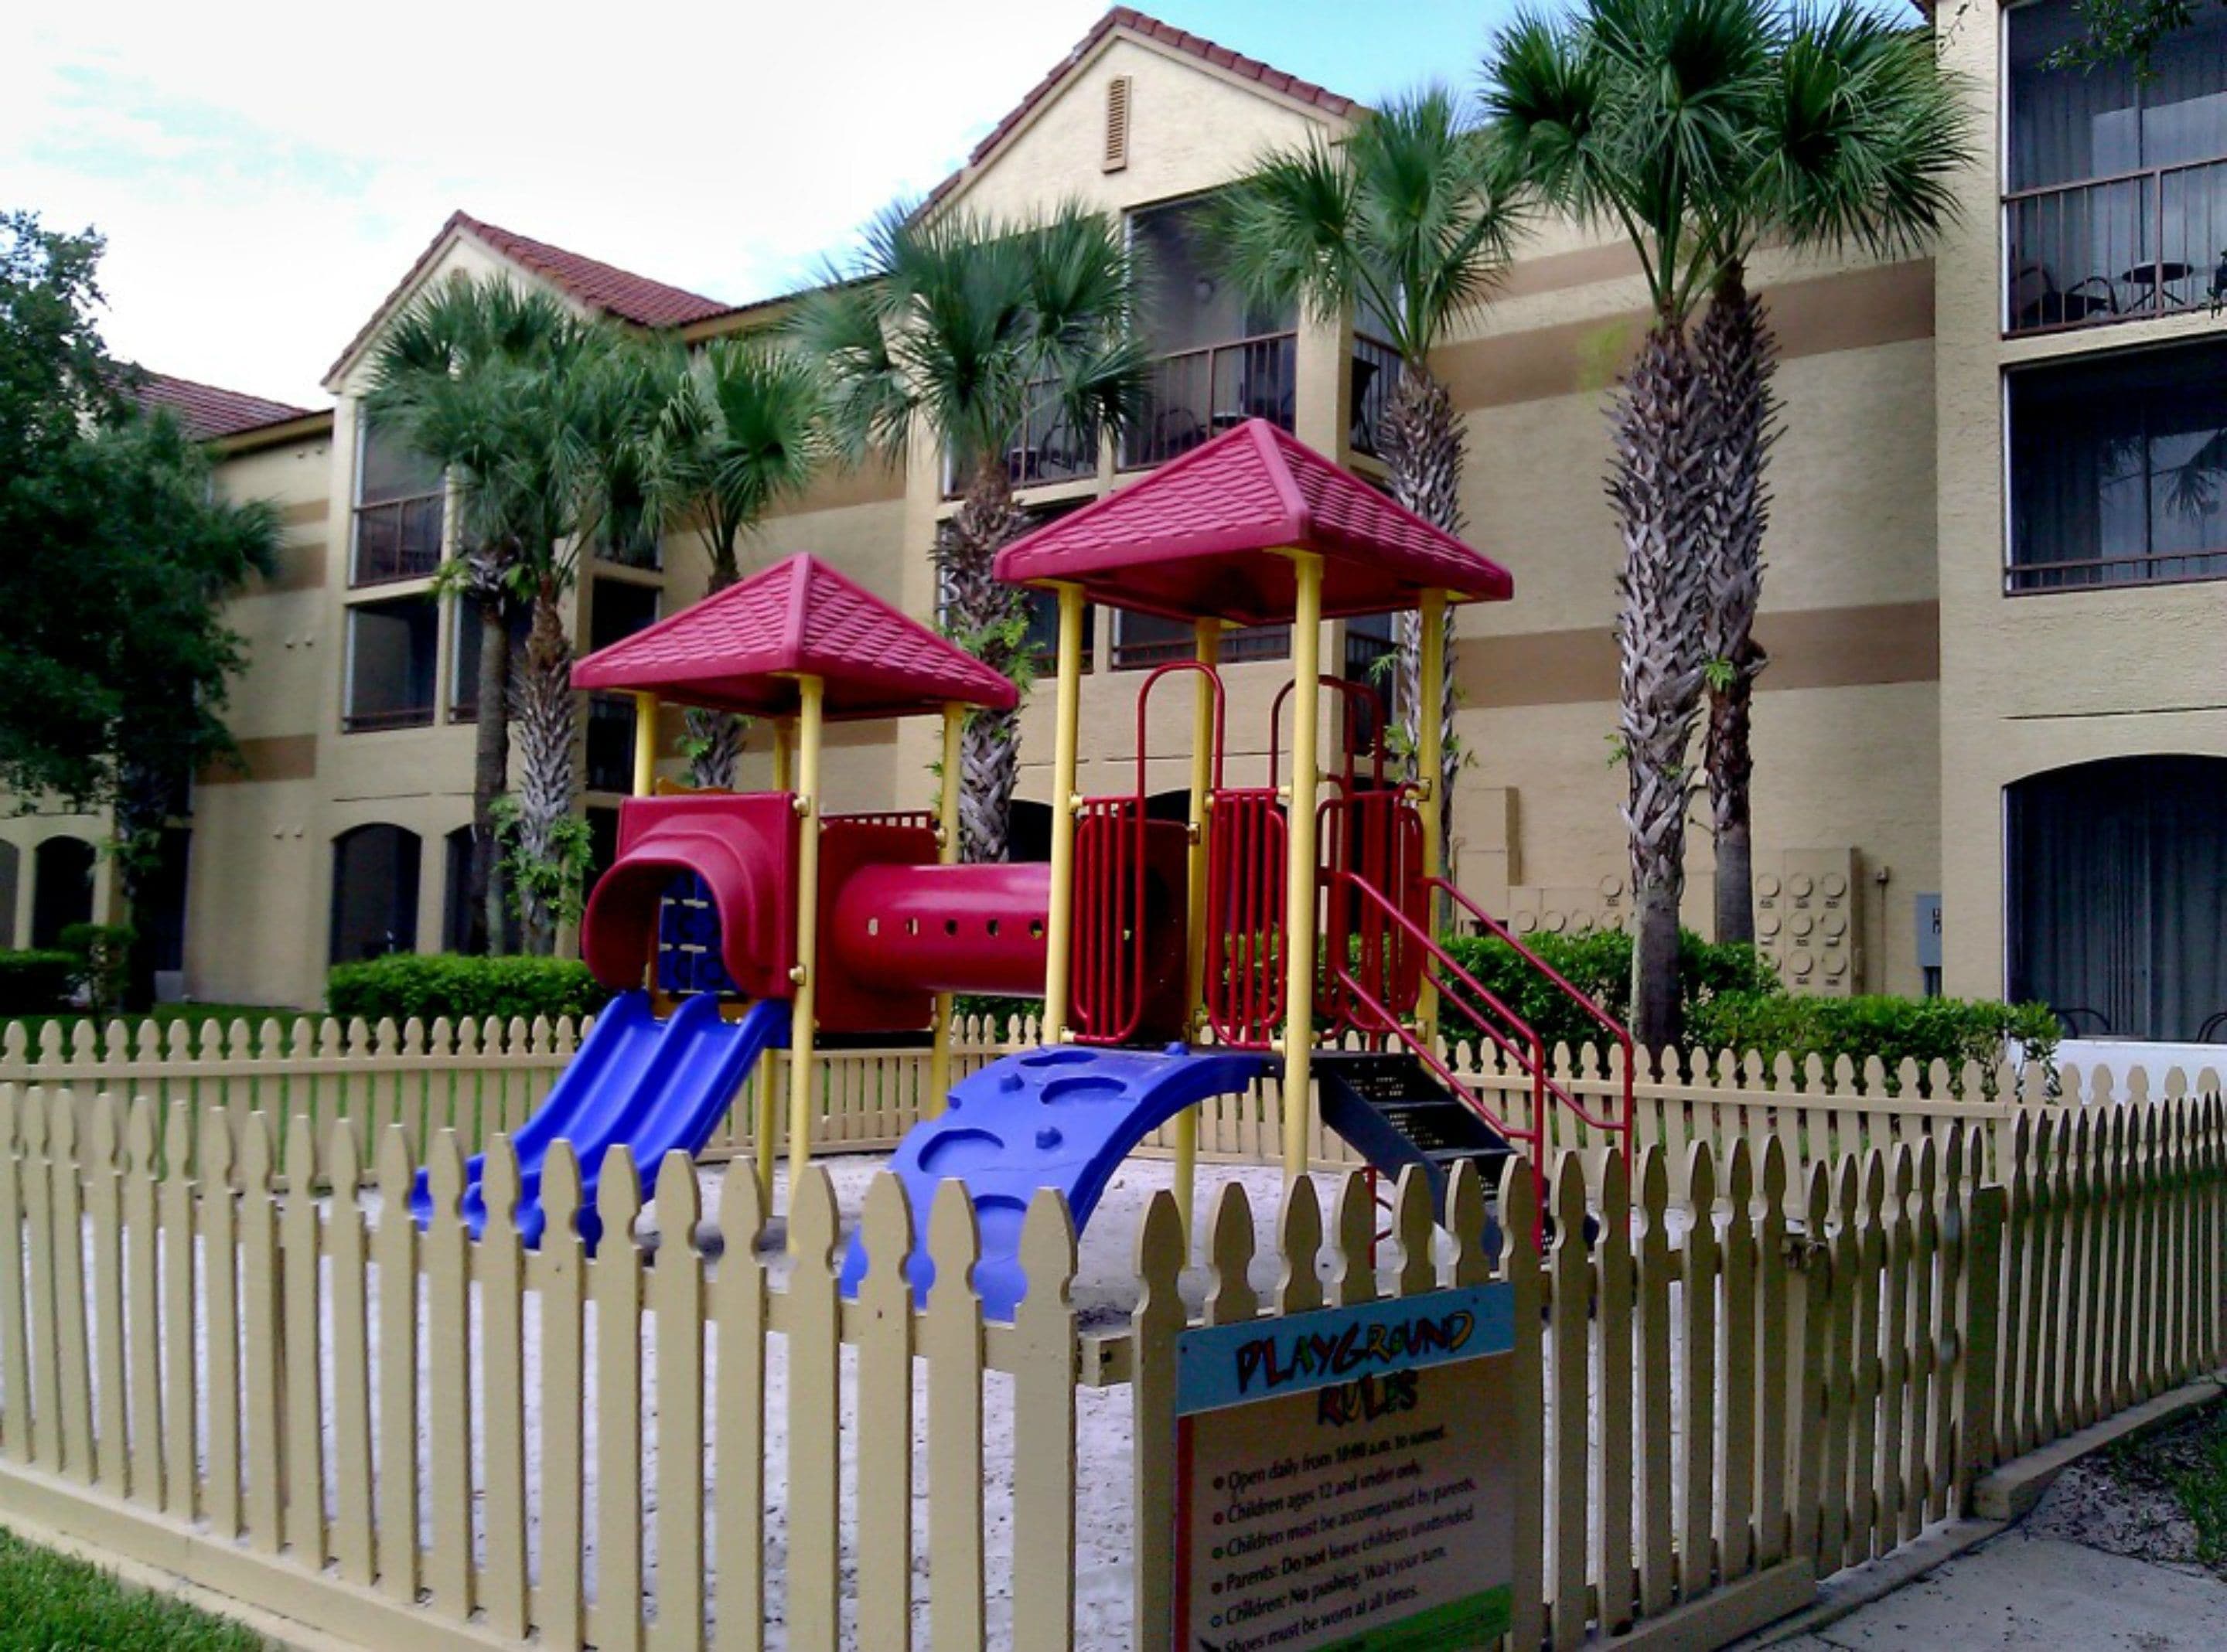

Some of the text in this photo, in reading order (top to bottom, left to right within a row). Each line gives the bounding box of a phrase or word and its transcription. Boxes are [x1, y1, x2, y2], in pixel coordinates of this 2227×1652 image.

[1236, 1310, 1475, 1395] PLAYGROUND
[1317, 1368, 1420, 1426] RULES
[1228, 1469, 1265, 1494] Open
[1269, 1457, 1299, 1478] daily
[1302, 1453, 1332, 1471] from
[1395, 1435, 1407, 1449] to
[1226, 1531, 1284, 1556] Children
[1287, 1521, 1316, 1541] must
[1320, 1514, 1335, 1531] be
[1418, 1487, 1431, 1504] by
[1227, 1497, 1284, 1524] Children
[1287, 1490, 1315, 1512] ages
[1318, 1482, 1332, 1498] 12
[1335, 1473, 1356, 1496] and
[1360, 1465, 1394, 1488] under
[1282, 1557, 1301, 1574] Do
[1304, 1547, 1325, 1567] not
[1329, 1541, 1359, 1561] leave
[1362, 1528, 1407, 1550] children
[1291, 1588, 1308, 1603] No
[1393, 1554, 1418, 1572] your
[1224, 1634, 1265, 1652] Shoes
[1267, 1622, 1299, 1645] must
[1302, 1616, 1318, 1634] be
[1321, 1606, 1352, 1626] worn
[1356, 1598, 1366, 1616] at
[1369, 1592, 1383, 1611] all
